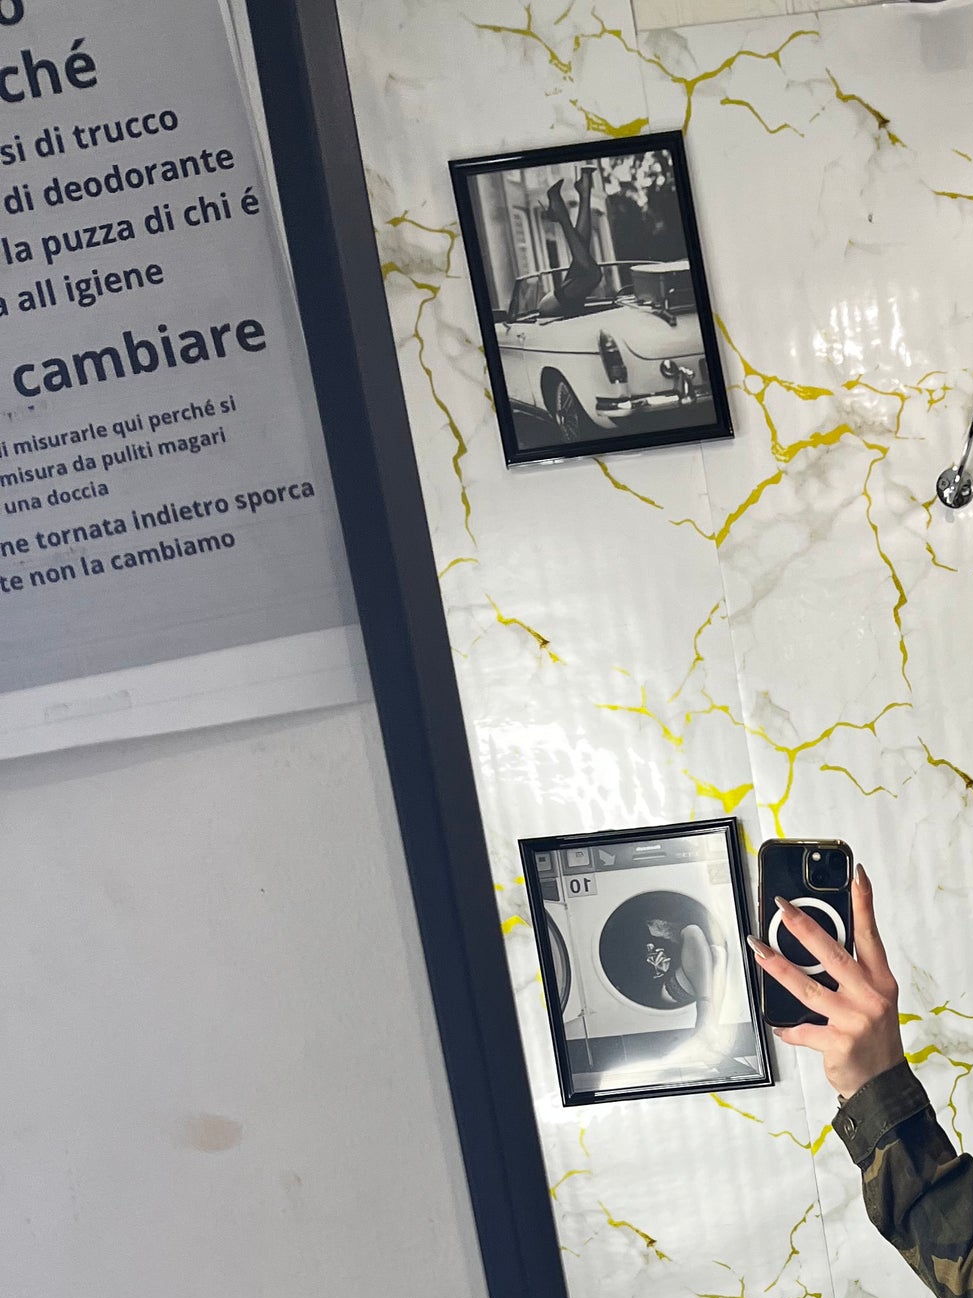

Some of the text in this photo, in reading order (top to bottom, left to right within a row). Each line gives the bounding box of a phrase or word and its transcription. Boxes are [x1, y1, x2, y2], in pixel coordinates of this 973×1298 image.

[0, 38, 97, 103] ché
[35, 125, 66, 158] di
[71, 109, 179, 150] trucco
[4, 148, 235, 214] di deodorante
[1, 187, 260, 265] la puzza di chi é
[18, 278, 57, 312] all
[64, 263, 164, 308] igiene
[13, 318, 267, 397] cambiare
[13, 422, 108, 455] misurarle
[112, 413, 144, 439] qui
[148, 398, 216, 433] perché
[220, 394, 237, 414] si
[0, 425, 227, 487] misura da puliti magari
[4, 480, 110, 515] una doccia
[34, 518, 128, 550] tornata
[132, 496, 230, 531] indietro
[235, 481, 316, 514] sporca
[30, 564, 77, 587] non
[80, 556, 105, 577] la
[111, 531, 236, 571] cambiamo
